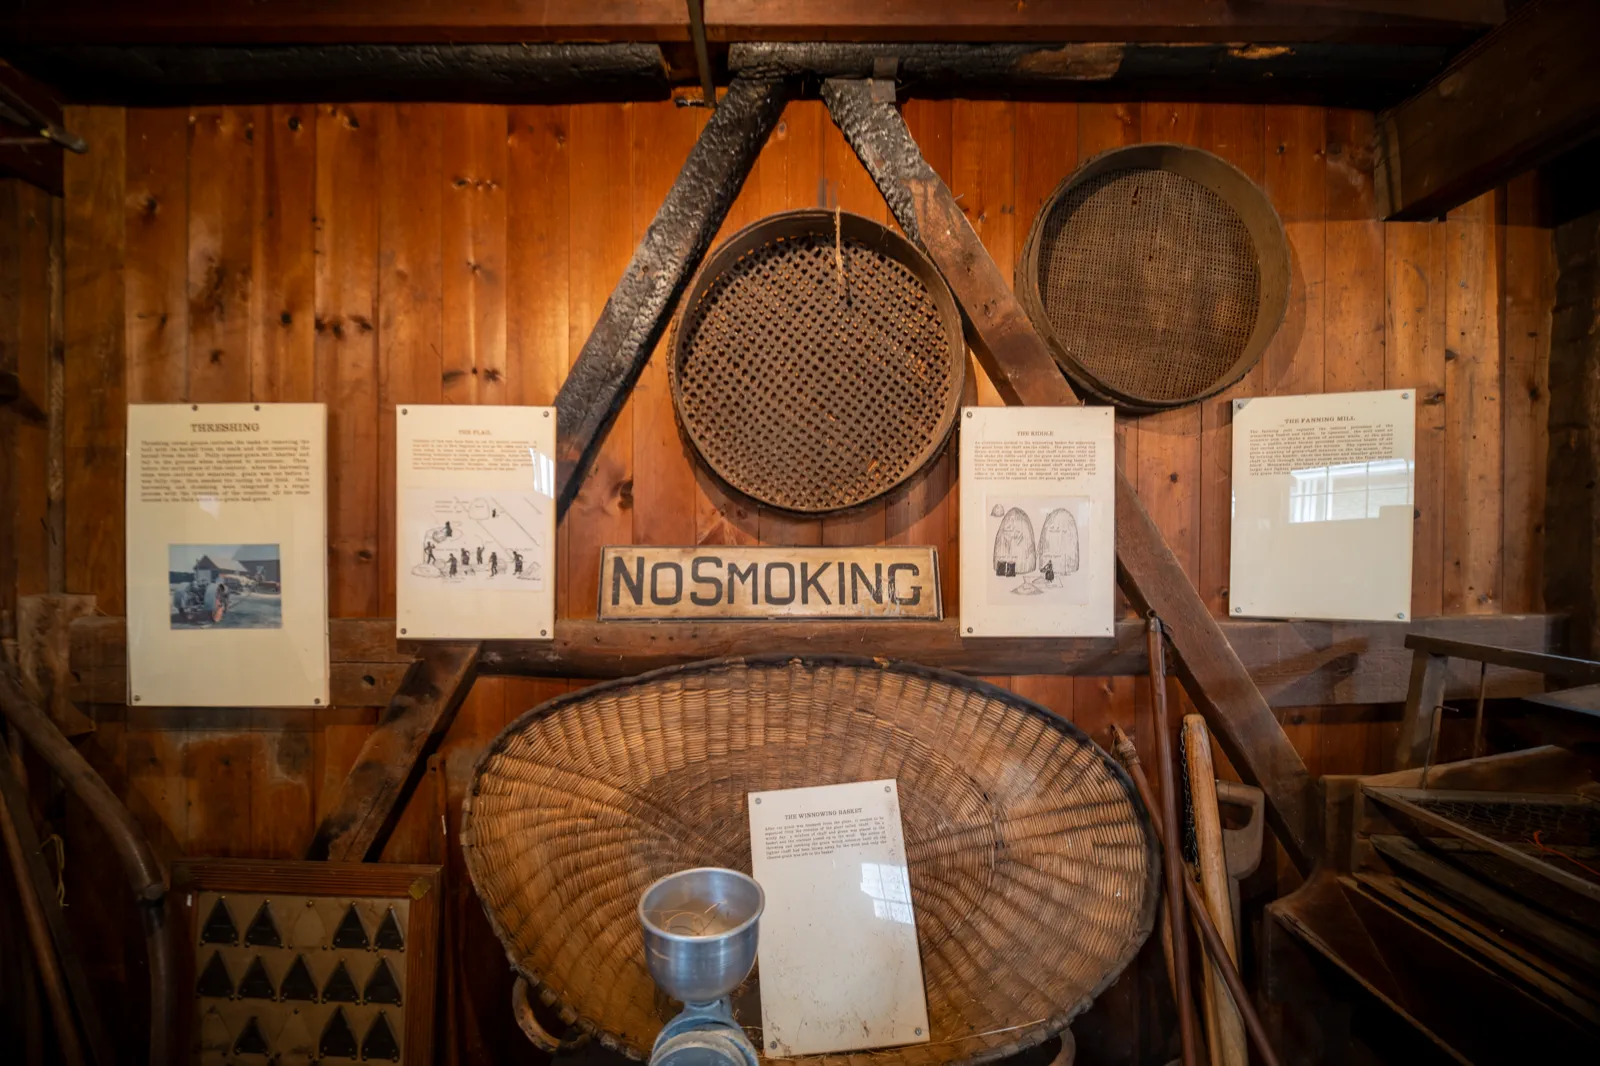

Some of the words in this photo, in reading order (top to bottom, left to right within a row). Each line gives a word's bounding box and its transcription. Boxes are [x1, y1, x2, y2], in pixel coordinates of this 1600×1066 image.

[190, 423, 260, 432] THRESHING
[798, 810, 837, 819] WINNOWING
[838, 808, 862, 816] BASKET
